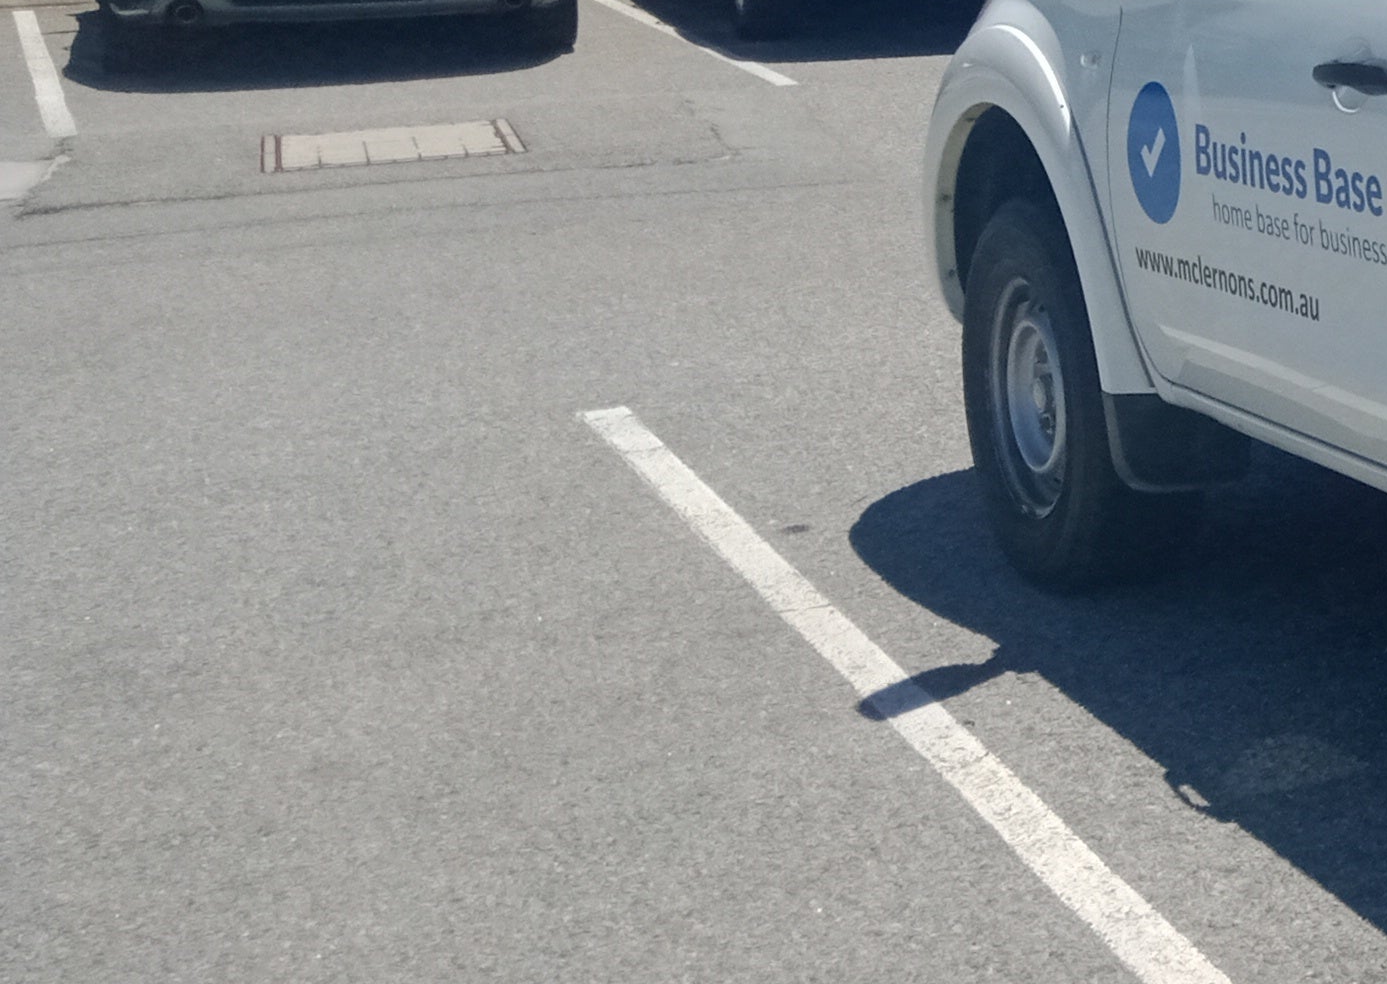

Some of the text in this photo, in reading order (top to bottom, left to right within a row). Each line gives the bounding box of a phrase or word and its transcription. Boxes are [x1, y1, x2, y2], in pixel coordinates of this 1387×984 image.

[1195, 124, 1384, 218] Business Base
[1211, 193, 1387, 267] home base for business
[1135, 245, 1320, 322] www.mclernons.com.au
